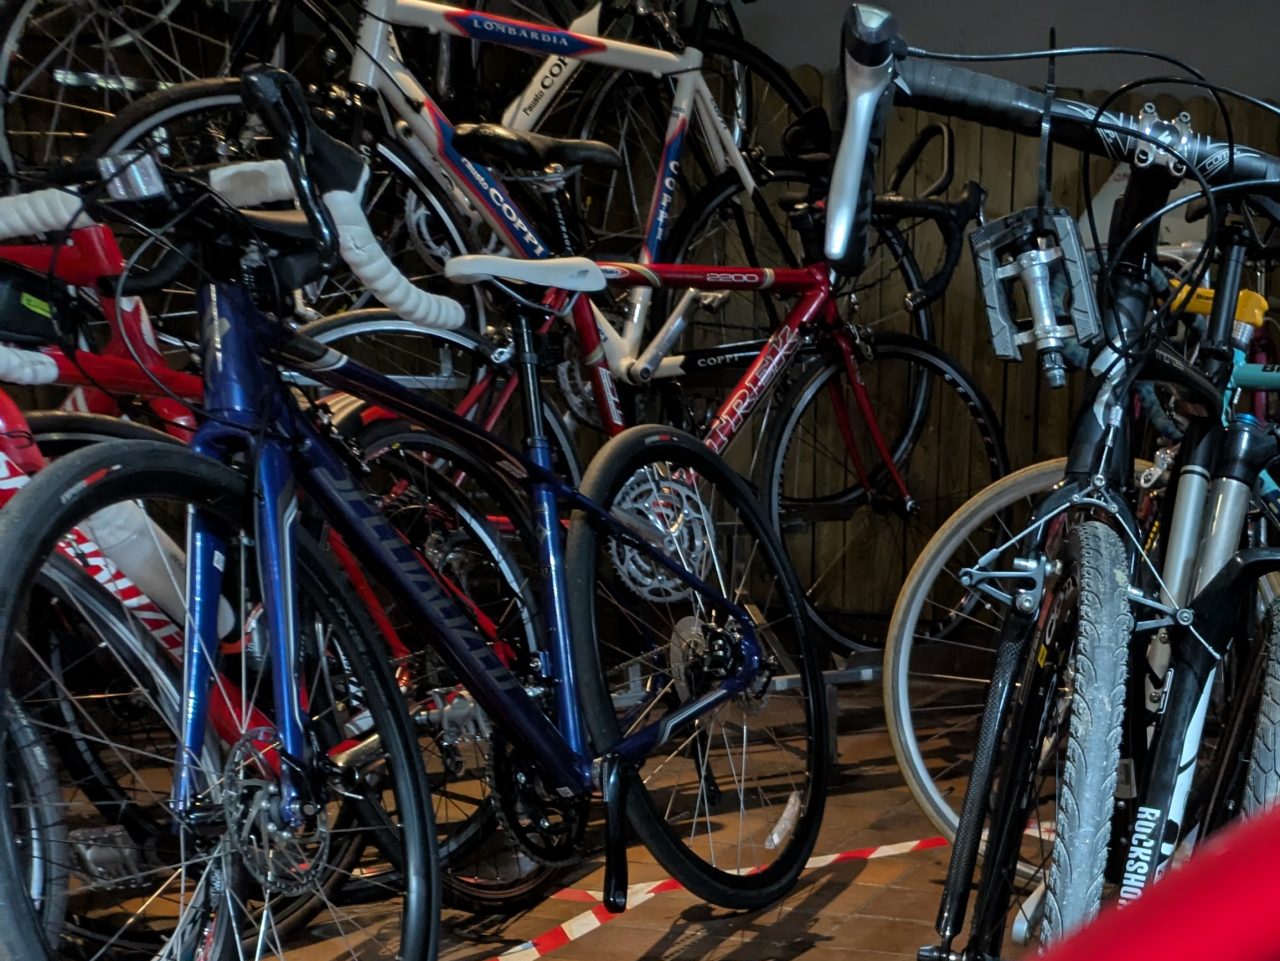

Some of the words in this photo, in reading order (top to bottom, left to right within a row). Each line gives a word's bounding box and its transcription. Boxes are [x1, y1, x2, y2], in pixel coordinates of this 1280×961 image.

[473, 19, 569, 47] LOMBARDIA
[488, 187, 545, 257] COPPI
[655, 160, 680, 241] COPPI
[706, 272, 760, 283] 2200
[697, 353, 740, 368] COPPI
[703, 324, 799, 455] TREK
